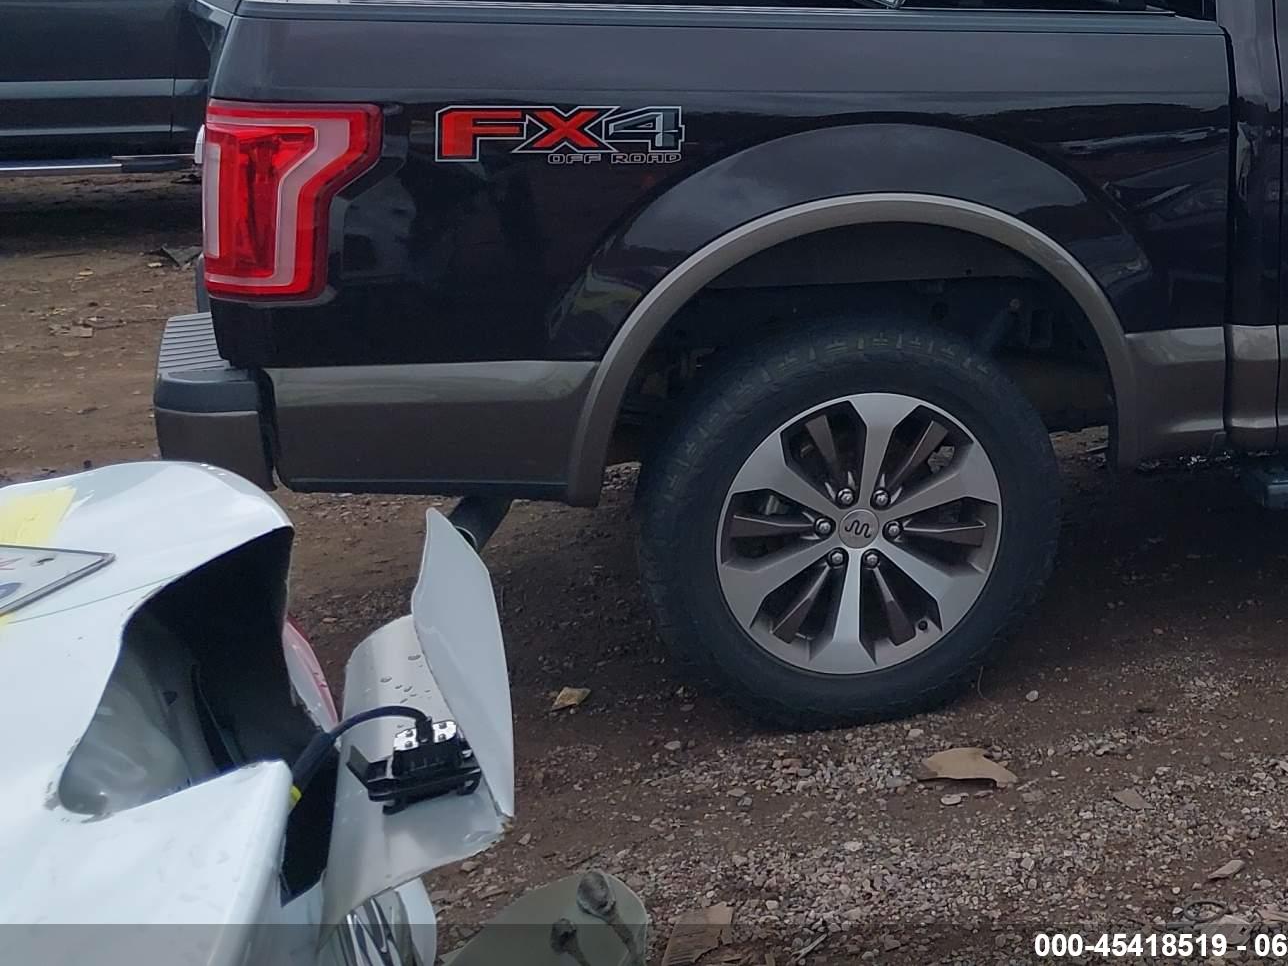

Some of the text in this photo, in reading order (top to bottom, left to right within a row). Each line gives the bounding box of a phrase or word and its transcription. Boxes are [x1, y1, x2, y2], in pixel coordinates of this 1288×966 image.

[435, 105, 685, 162] FX4
[548, 153, 682, 164] OFF ROAD
